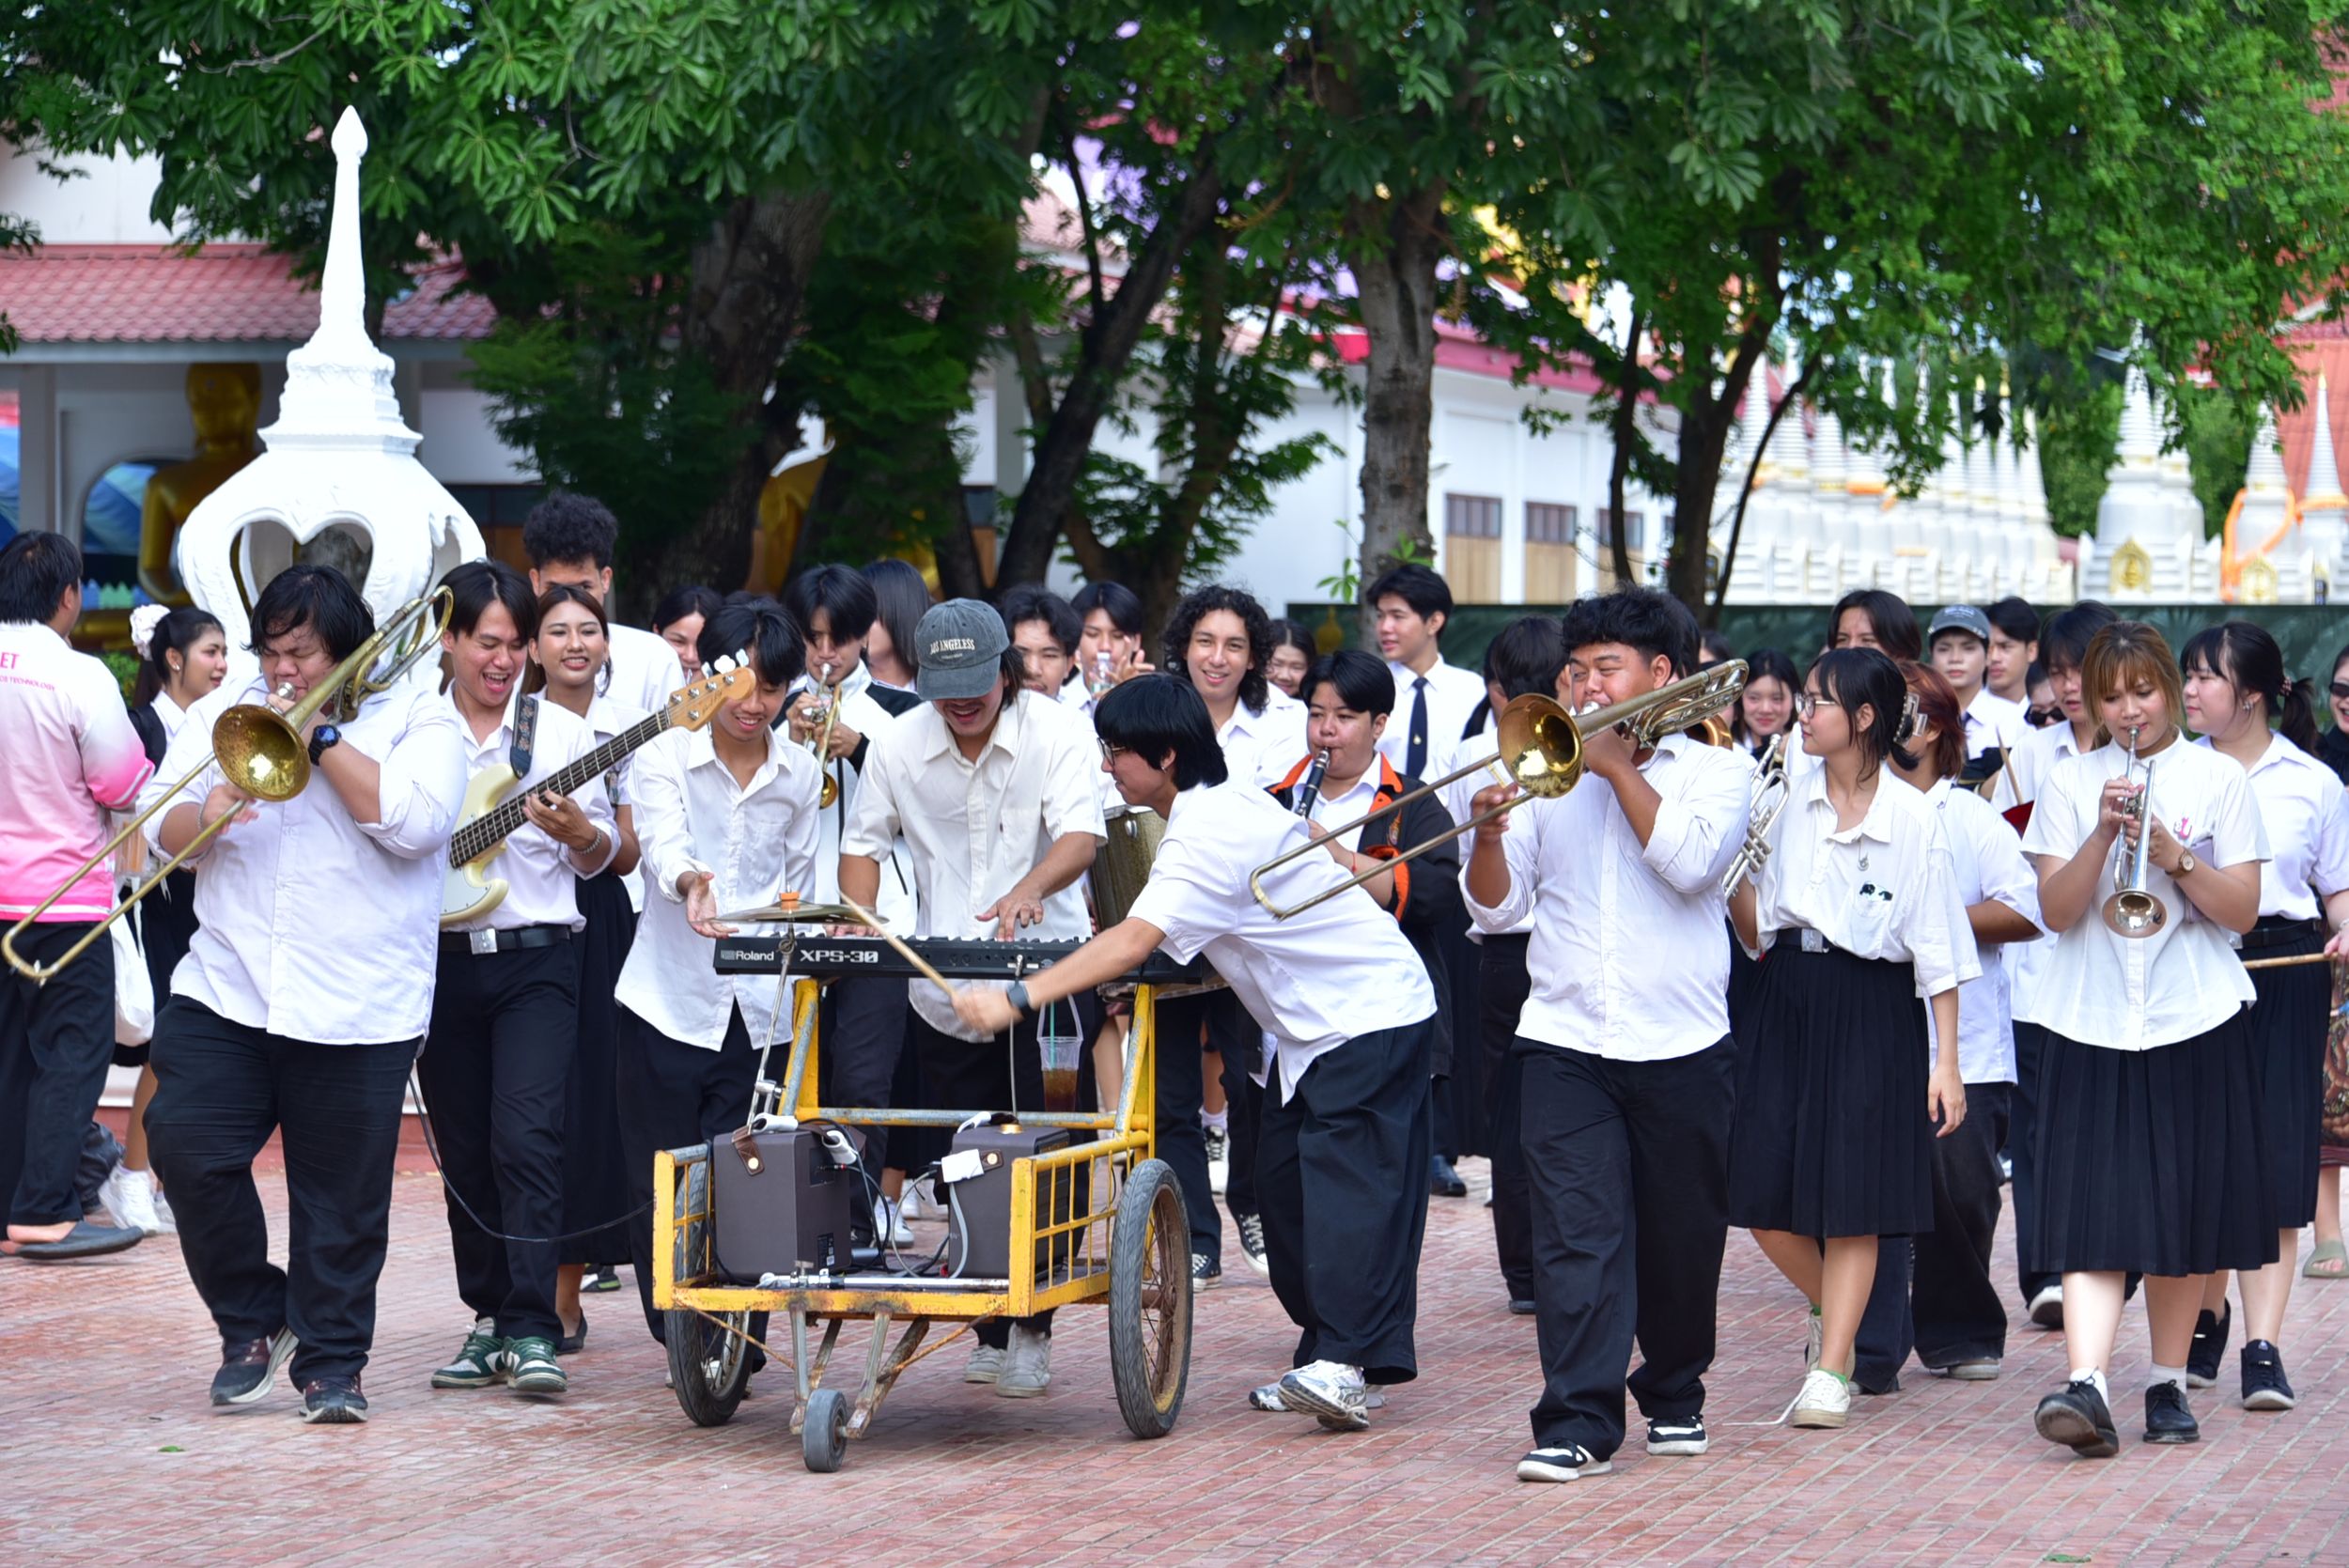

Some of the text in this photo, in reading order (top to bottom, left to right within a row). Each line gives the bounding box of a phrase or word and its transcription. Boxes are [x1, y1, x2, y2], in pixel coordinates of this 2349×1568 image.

[0, 652, 20, 669] ET
[736, 950, 879, 963] Roland XPS-30
